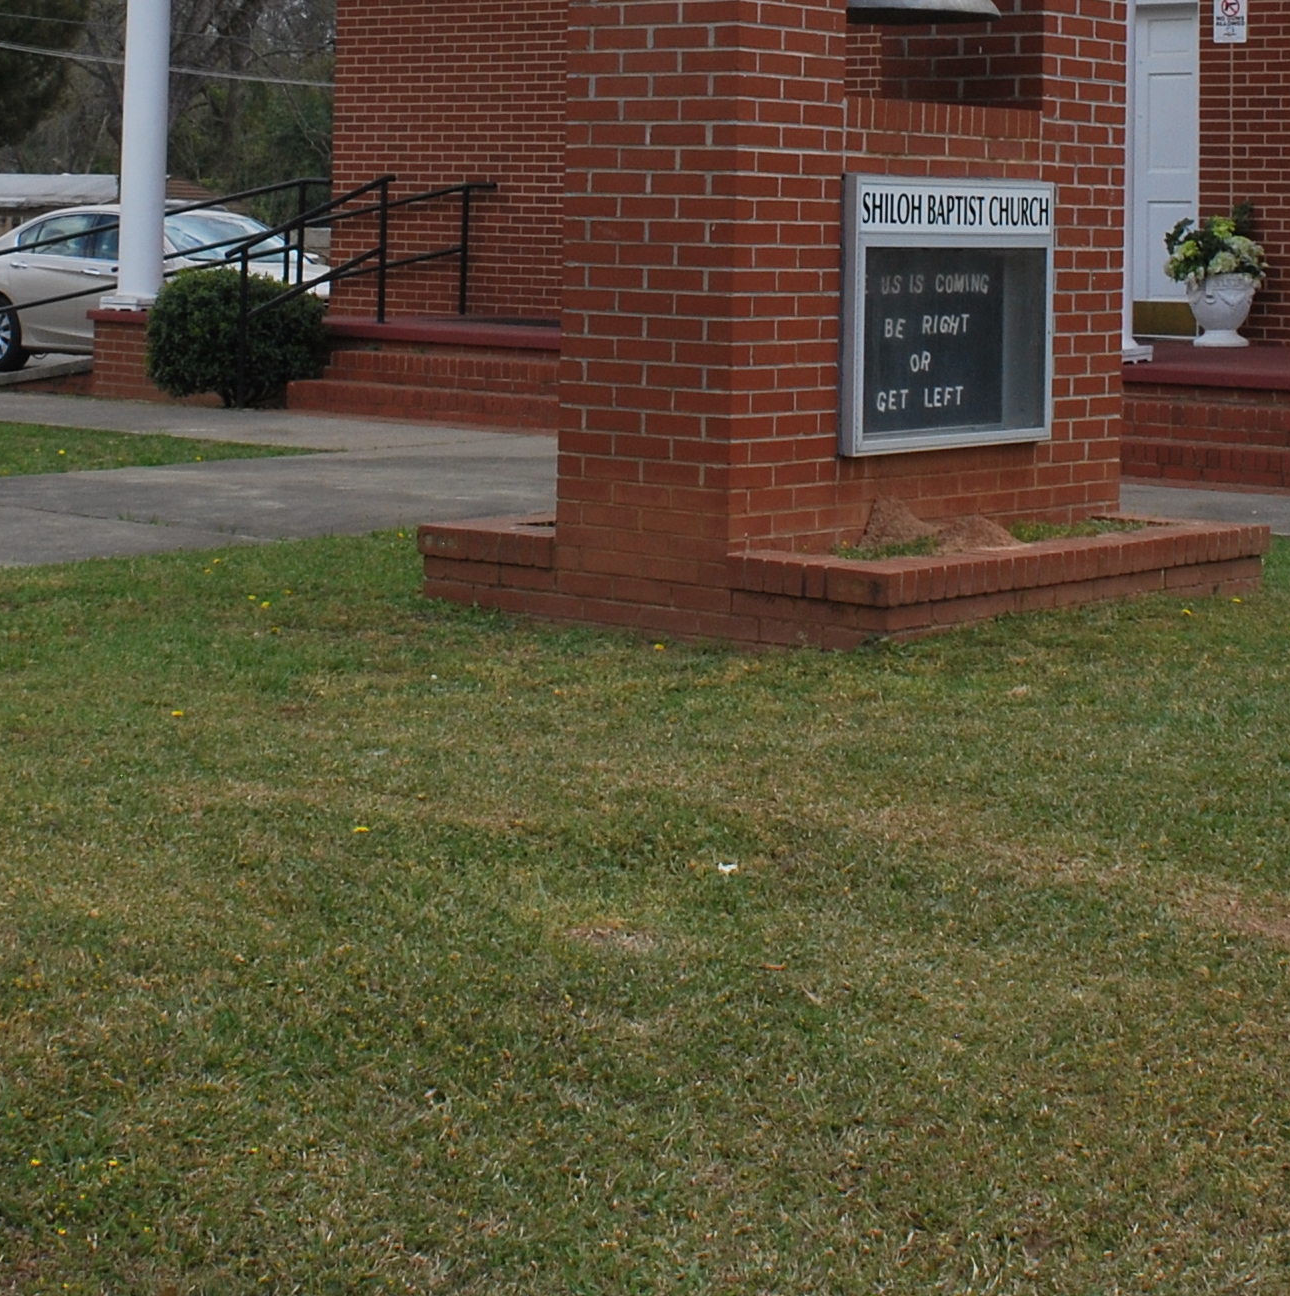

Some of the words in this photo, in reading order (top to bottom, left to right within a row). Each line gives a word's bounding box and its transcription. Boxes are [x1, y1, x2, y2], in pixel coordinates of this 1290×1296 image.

[862, 192, 922, 224] SHILOH
[927, 194, 985, 226] BAPTIST
[988, 196, 1049, 226] CHURCH
[909, 274, 924, 293] IS
[935, 273, 989, 294] COMING
[884, 318, 906, 339] BE
[922, 313, 969, 336] RIGHT
[910, 350, 931, 373] OR
[876, 389, 909, 413] GET
[923, 386, 964, 408] LEFT
